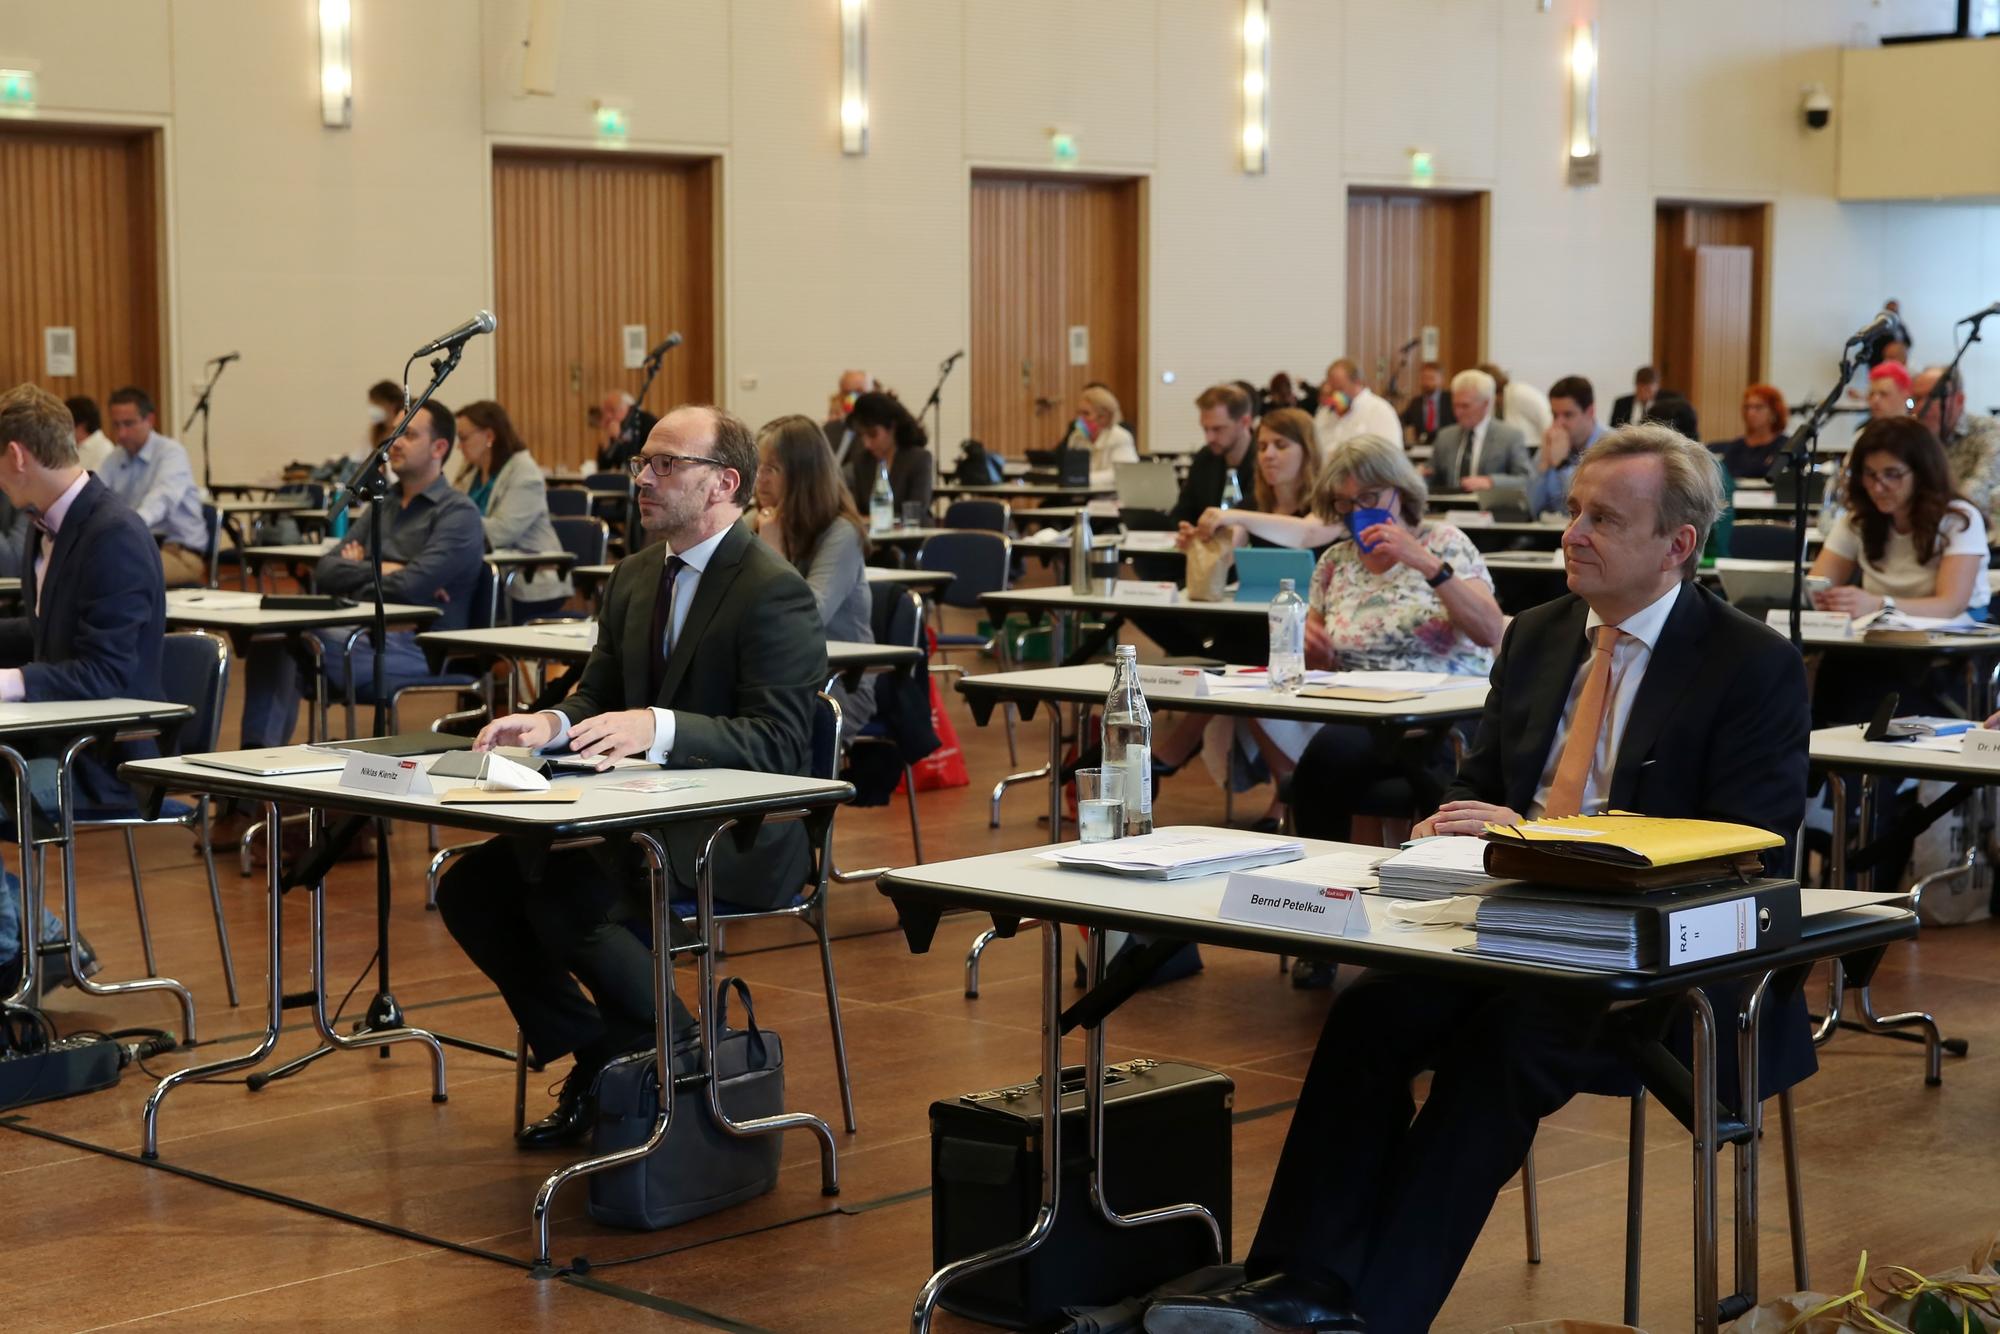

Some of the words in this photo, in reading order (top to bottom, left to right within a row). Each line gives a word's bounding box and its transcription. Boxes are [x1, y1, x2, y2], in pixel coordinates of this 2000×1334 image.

[1977, 743, 1990, 752] Dr.
[361, 767, 378, 777] Niklas
[378, 769, 398, 780] Kienitz
[1250, 893, 1282, 908] Bernd
[1282, 898, 1326, 914] Petelkau
